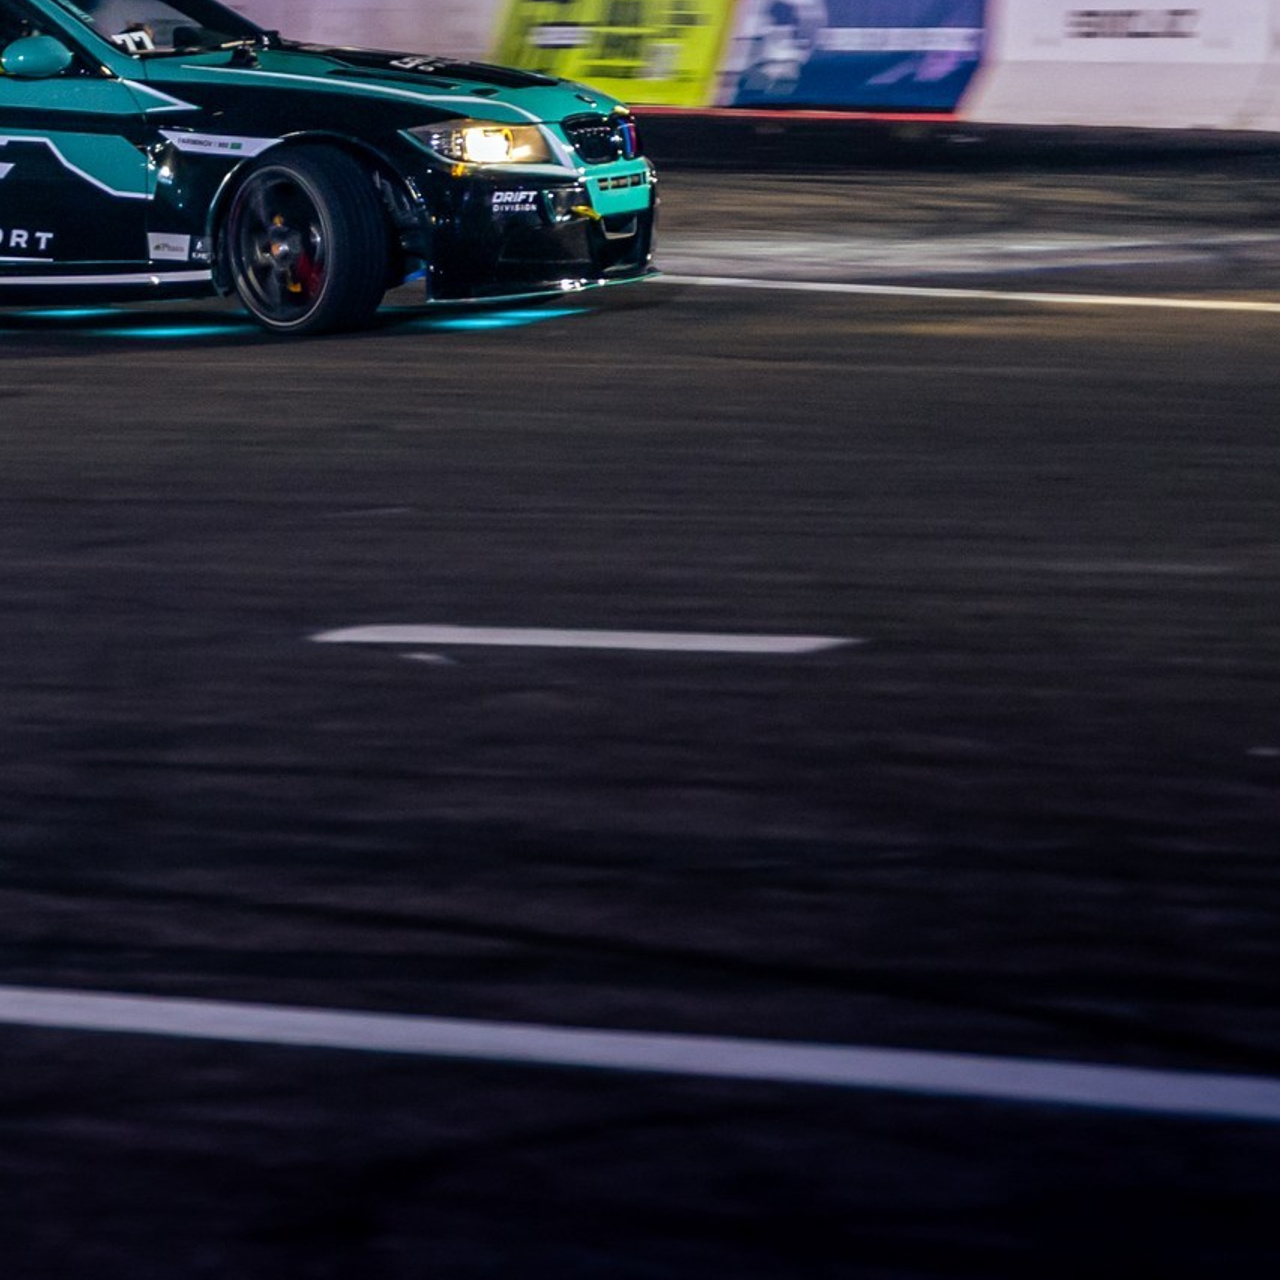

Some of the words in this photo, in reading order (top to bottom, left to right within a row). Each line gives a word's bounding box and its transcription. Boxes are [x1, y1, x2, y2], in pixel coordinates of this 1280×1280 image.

[111, 30, 156, 52] 77
[492, 191, 538, 203] DRIFT
[492, 204, 537, 212] DIVISION
